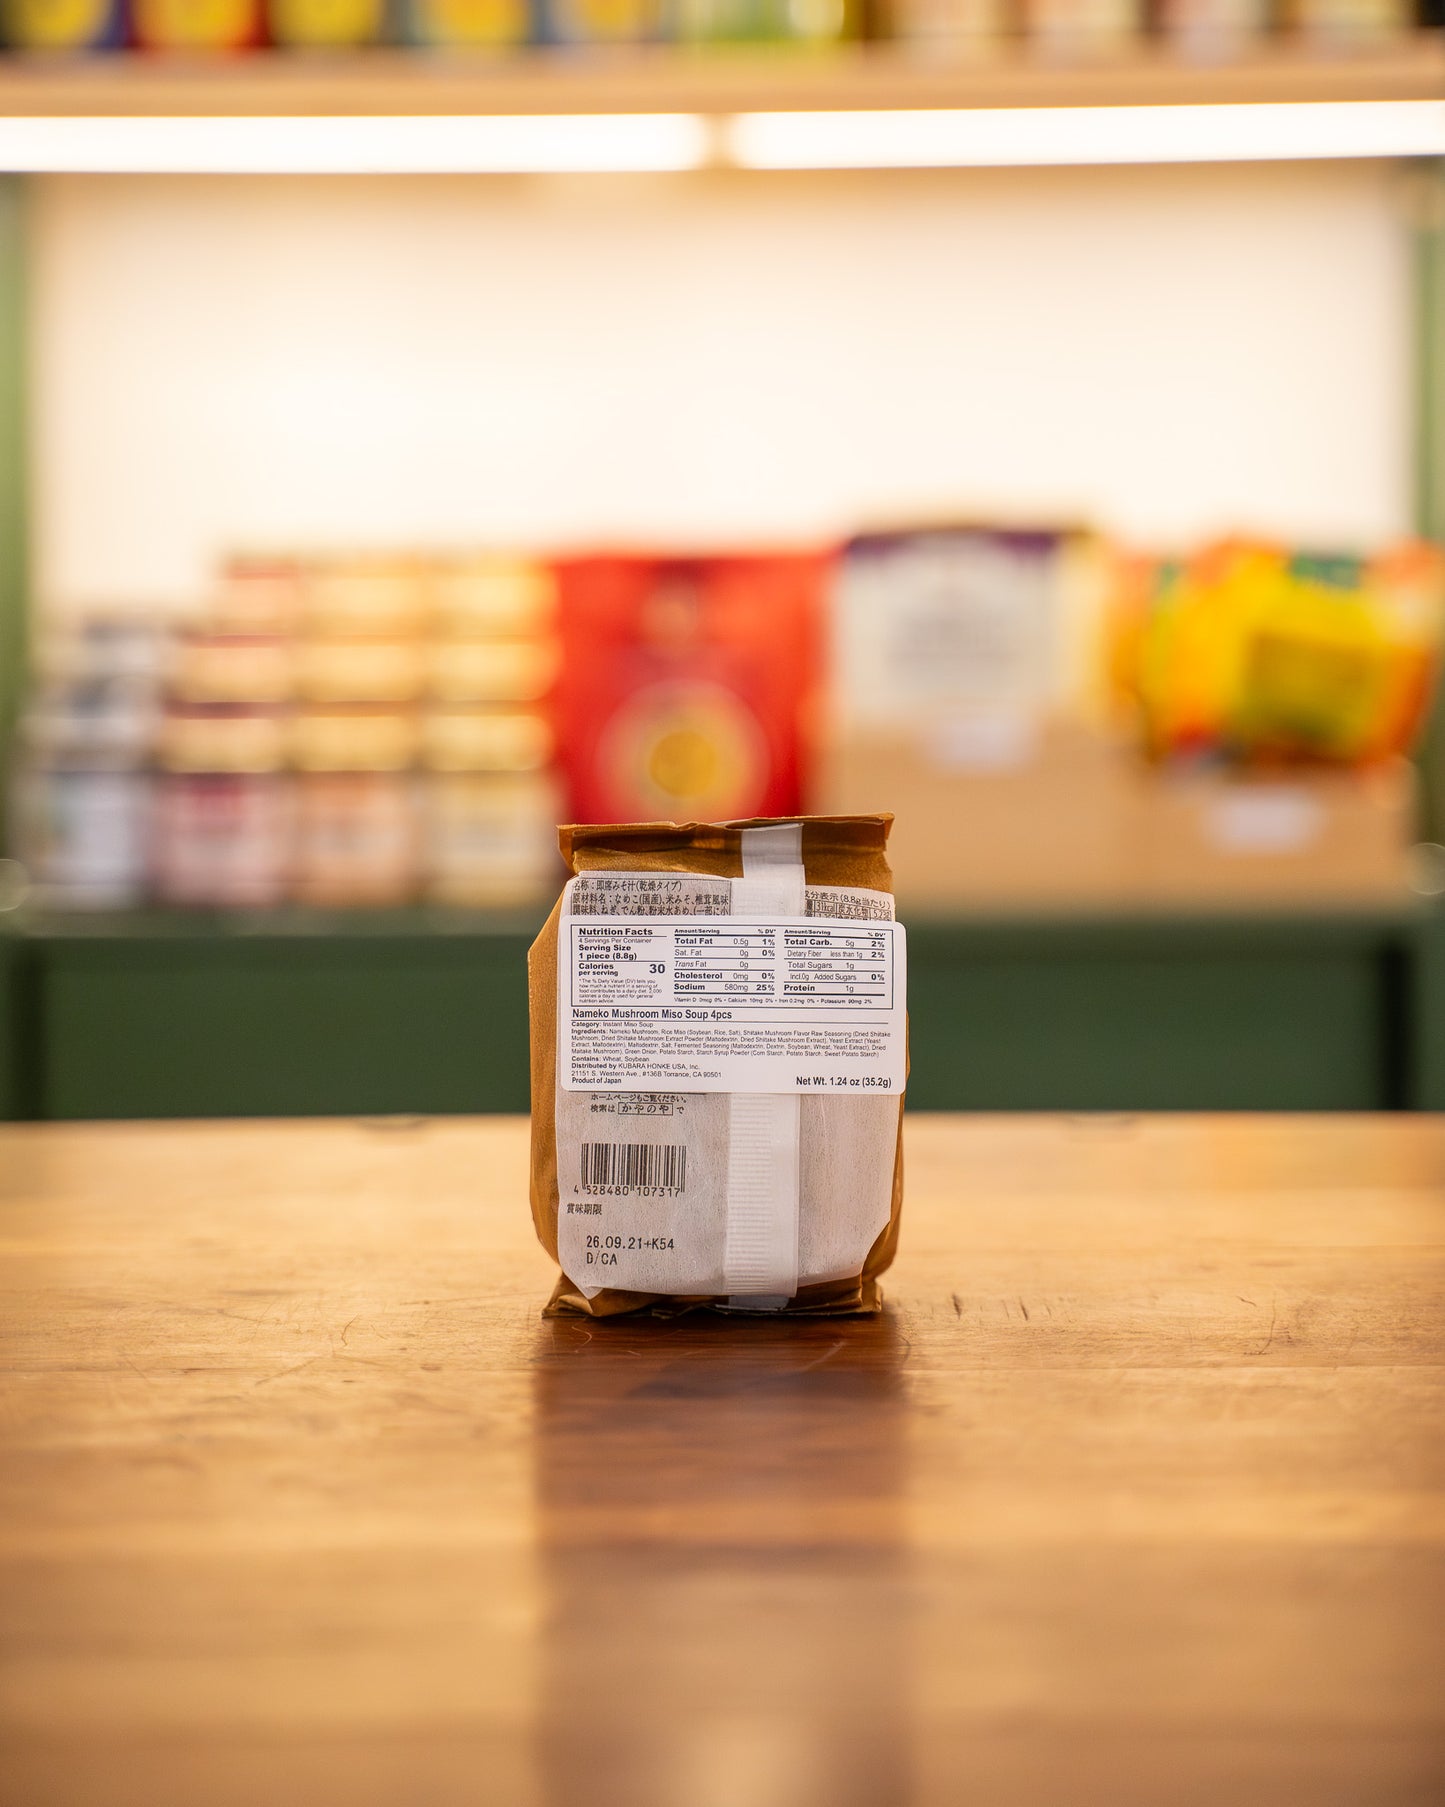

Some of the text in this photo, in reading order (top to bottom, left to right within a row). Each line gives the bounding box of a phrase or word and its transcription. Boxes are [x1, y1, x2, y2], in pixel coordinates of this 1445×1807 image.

[579, 928, 623, 936] Nutrition
[788, 950, 807, 958] Dietary
[808, 950, 822, 958] Fiber
[650, 964, 665, 974] 30
[740, 961, 748, 969] 0g
[808, 962, 832, 970] Sugars
[725, 984, 748, 992] 580mg
[573, 1009, 732, 1021] Nameko Mushroom Miso Soup 4pcs
[796, 1076, 811, 1085] Net
[813, 1077, 827, 1085] Wt.
[830, 1077, 847, 1086] 1.24
[862, 1077, 891, 1088] (35.2g)
[590, 1104, 684, 1114] 検索は かやのや で
[574, 1186, 680, 1197] 4 528480 107317
[587, 1252, 617, 1265] D/CA
